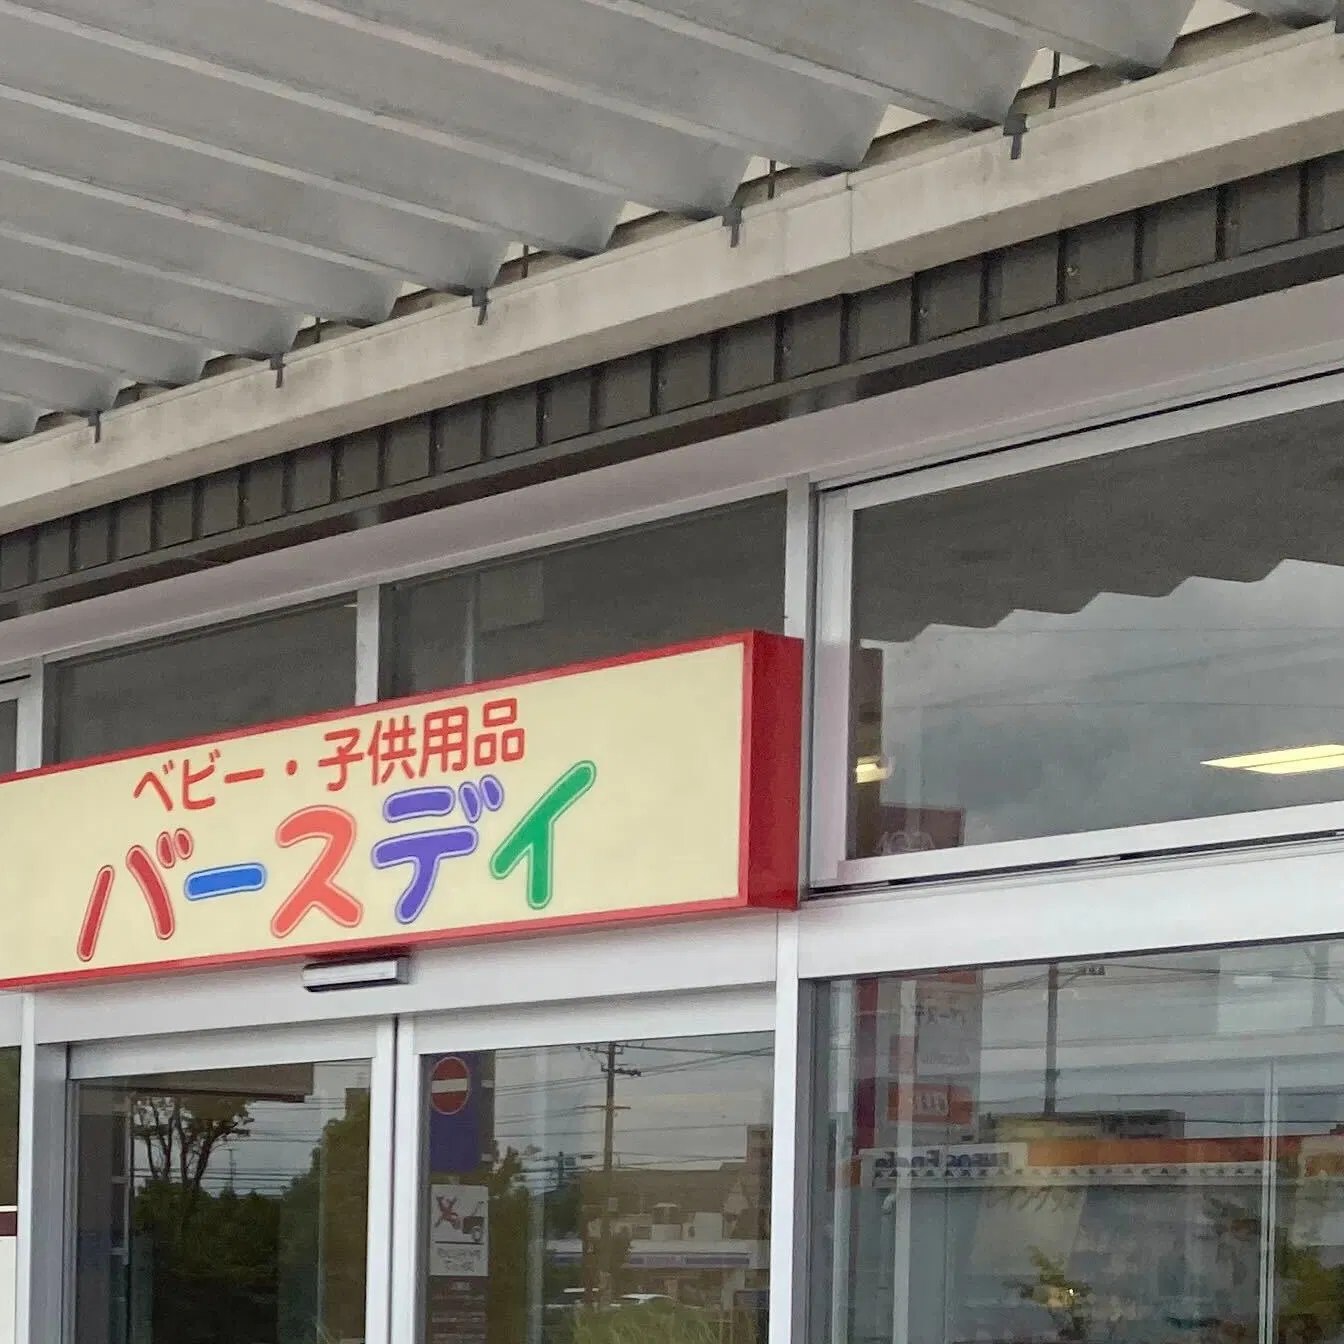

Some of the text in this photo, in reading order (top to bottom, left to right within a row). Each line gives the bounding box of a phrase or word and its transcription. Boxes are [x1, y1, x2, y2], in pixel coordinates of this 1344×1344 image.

[132, 697, 525, 812] ベビー・子供用品
[76, 759, 597, 962] バースデイ
